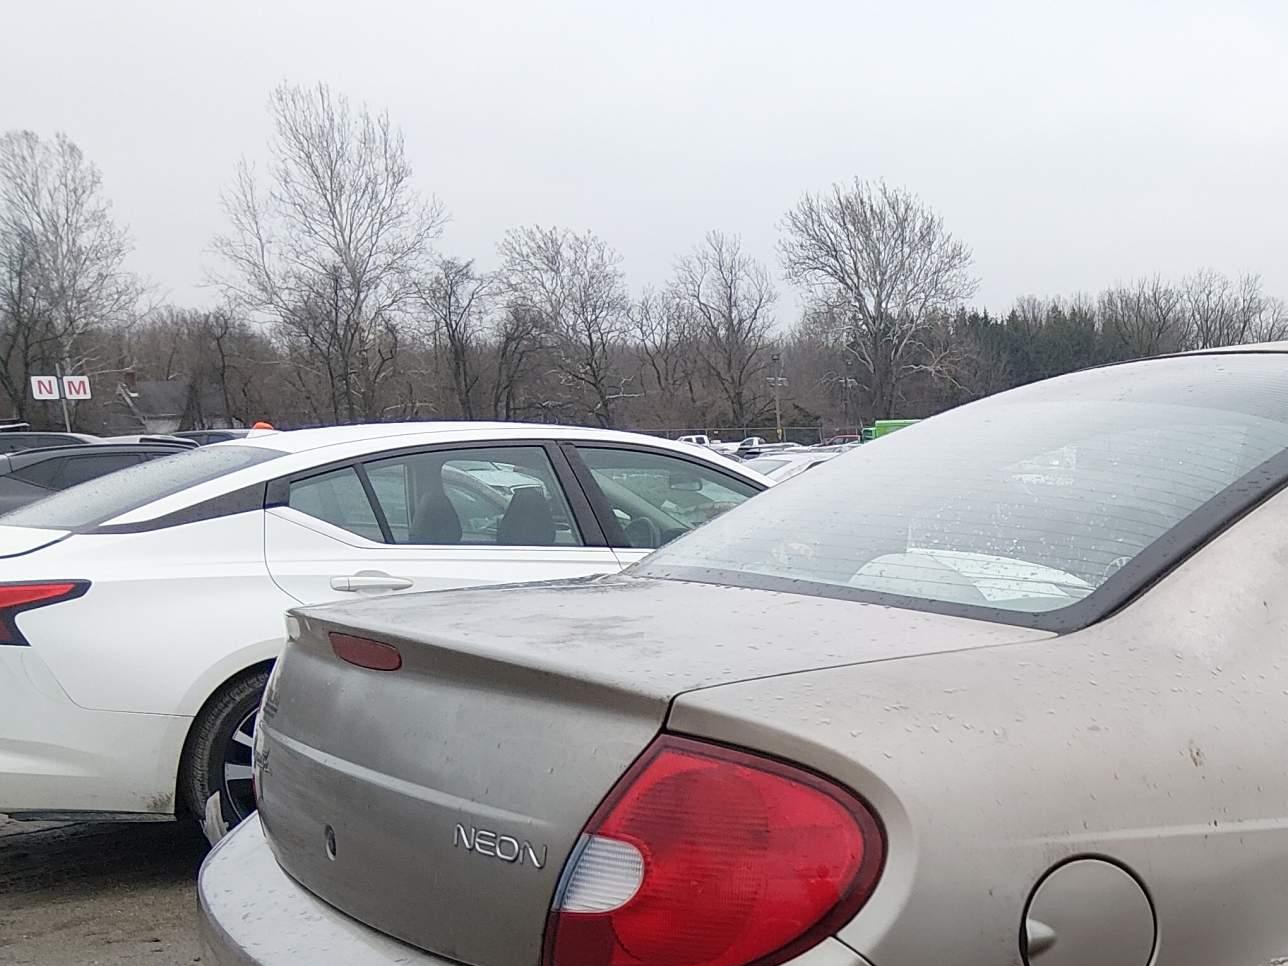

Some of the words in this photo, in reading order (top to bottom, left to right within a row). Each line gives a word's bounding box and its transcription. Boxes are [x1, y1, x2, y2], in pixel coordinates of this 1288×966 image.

[37, 380, 53, 395] N
[67, 380, 87, 396] M
[453, 823, 548, 869] NEON
